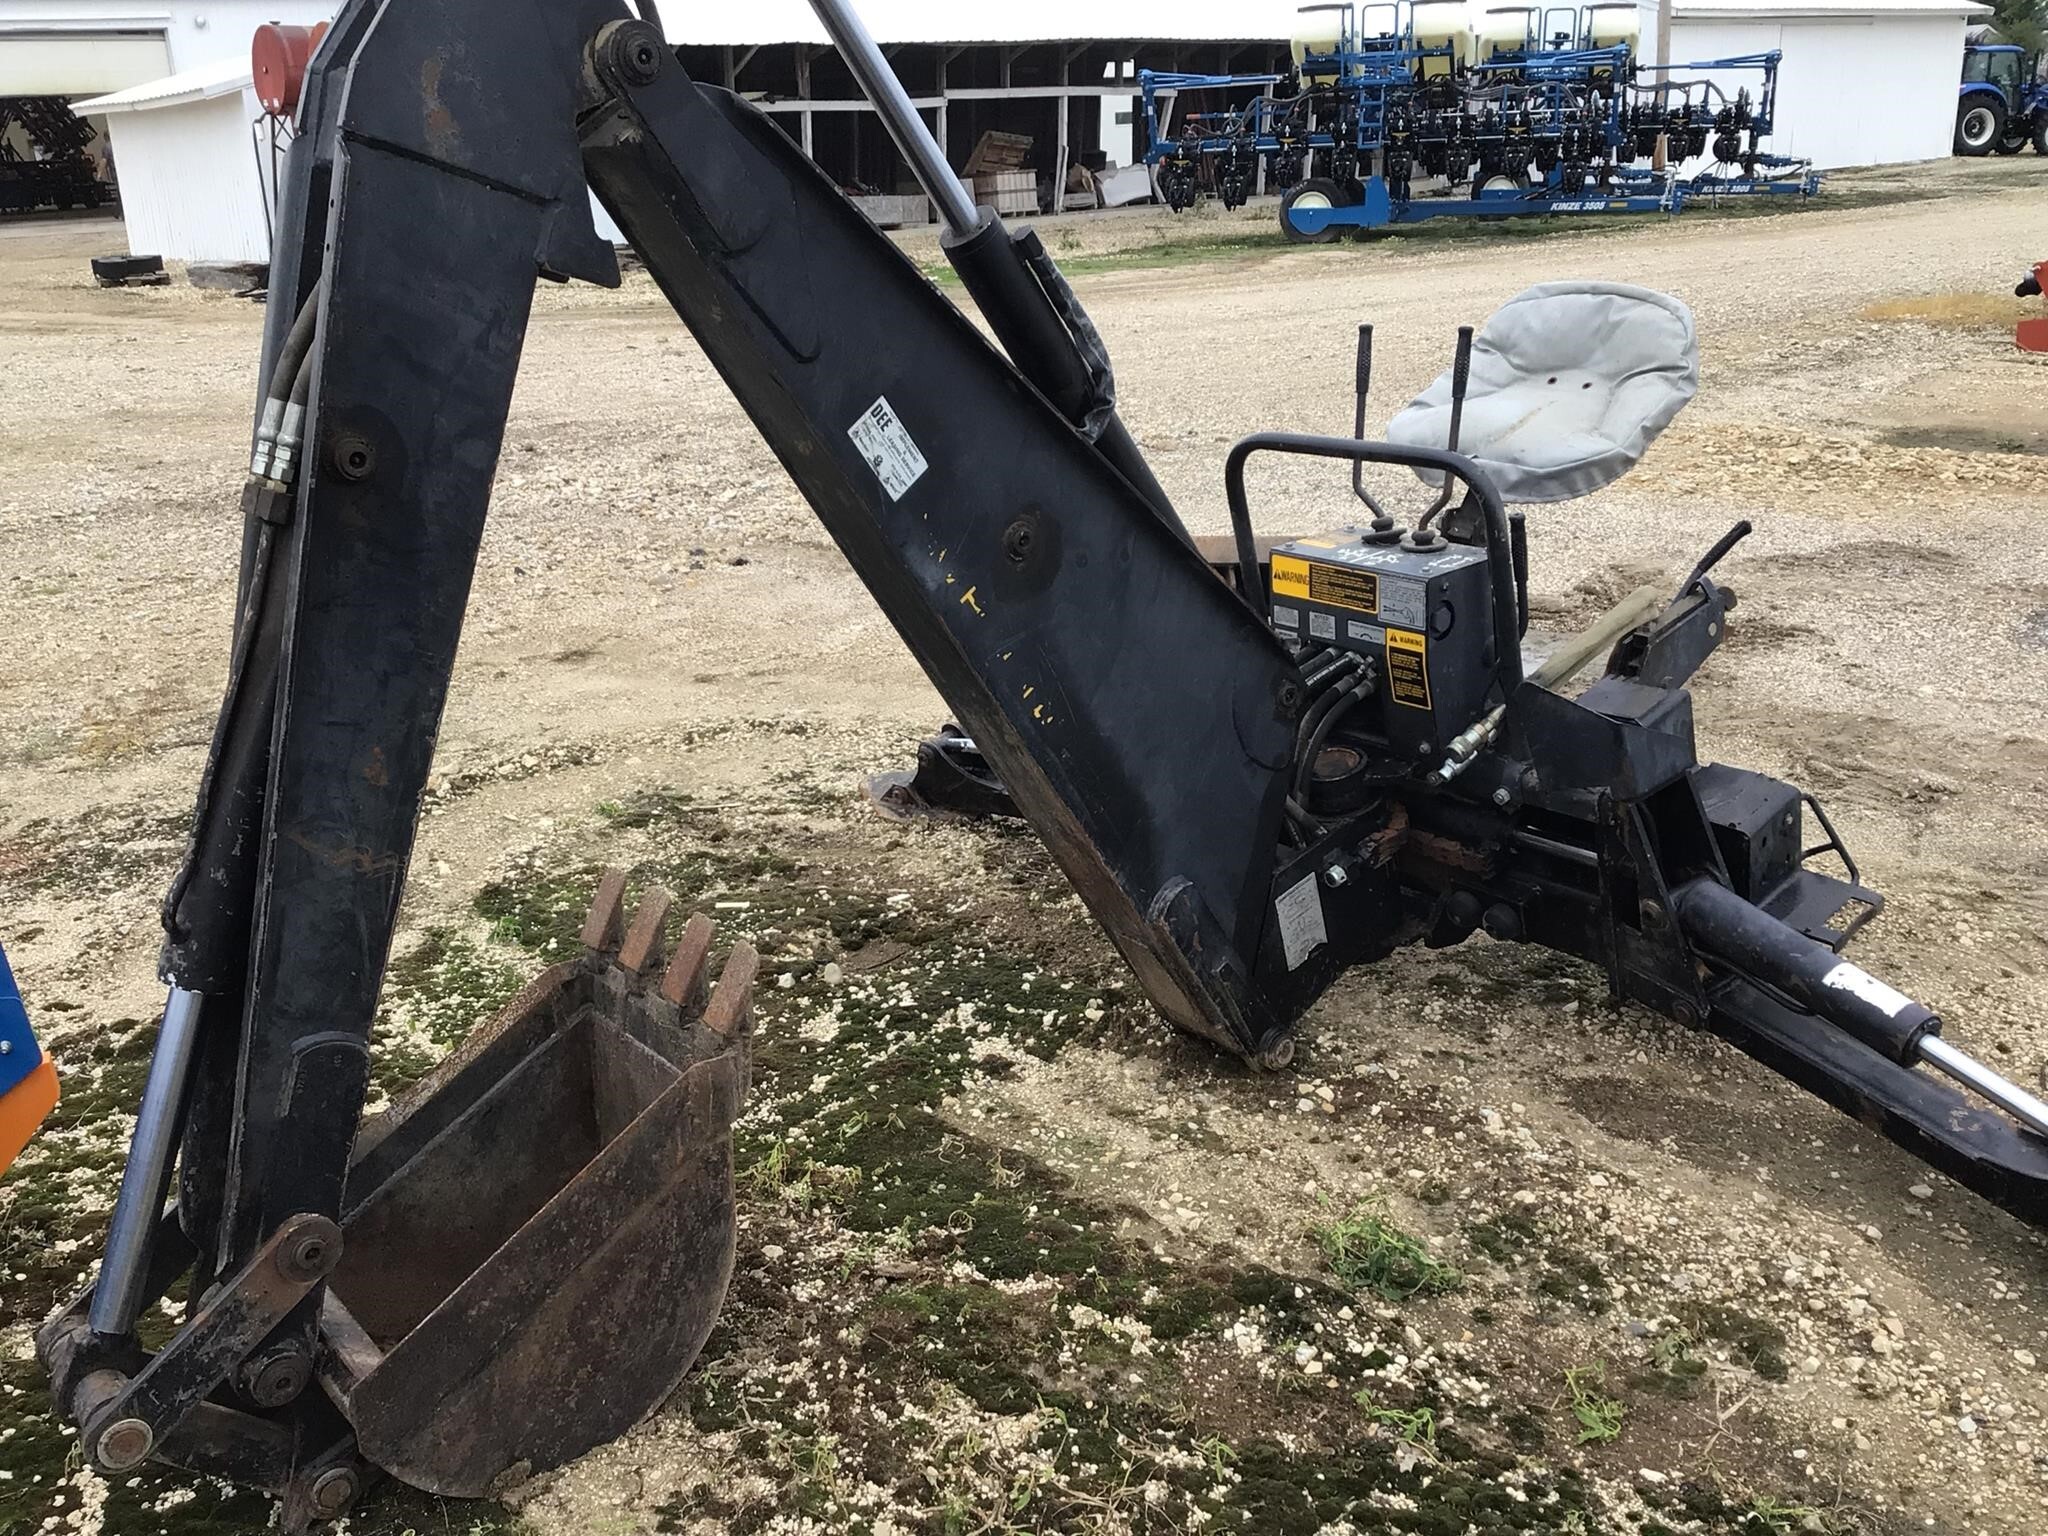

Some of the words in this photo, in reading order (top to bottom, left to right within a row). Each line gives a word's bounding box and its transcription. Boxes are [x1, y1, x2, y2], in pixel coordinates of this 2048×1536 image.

[1550, 201, 1582, 211] KINZE
[1583, 201, 1606, 210] 3505
[870, 402, 892, 432] DEE
[1281, 570, 1309, 586] WARNING
[1400, 636, 1423, 648] WARNING
